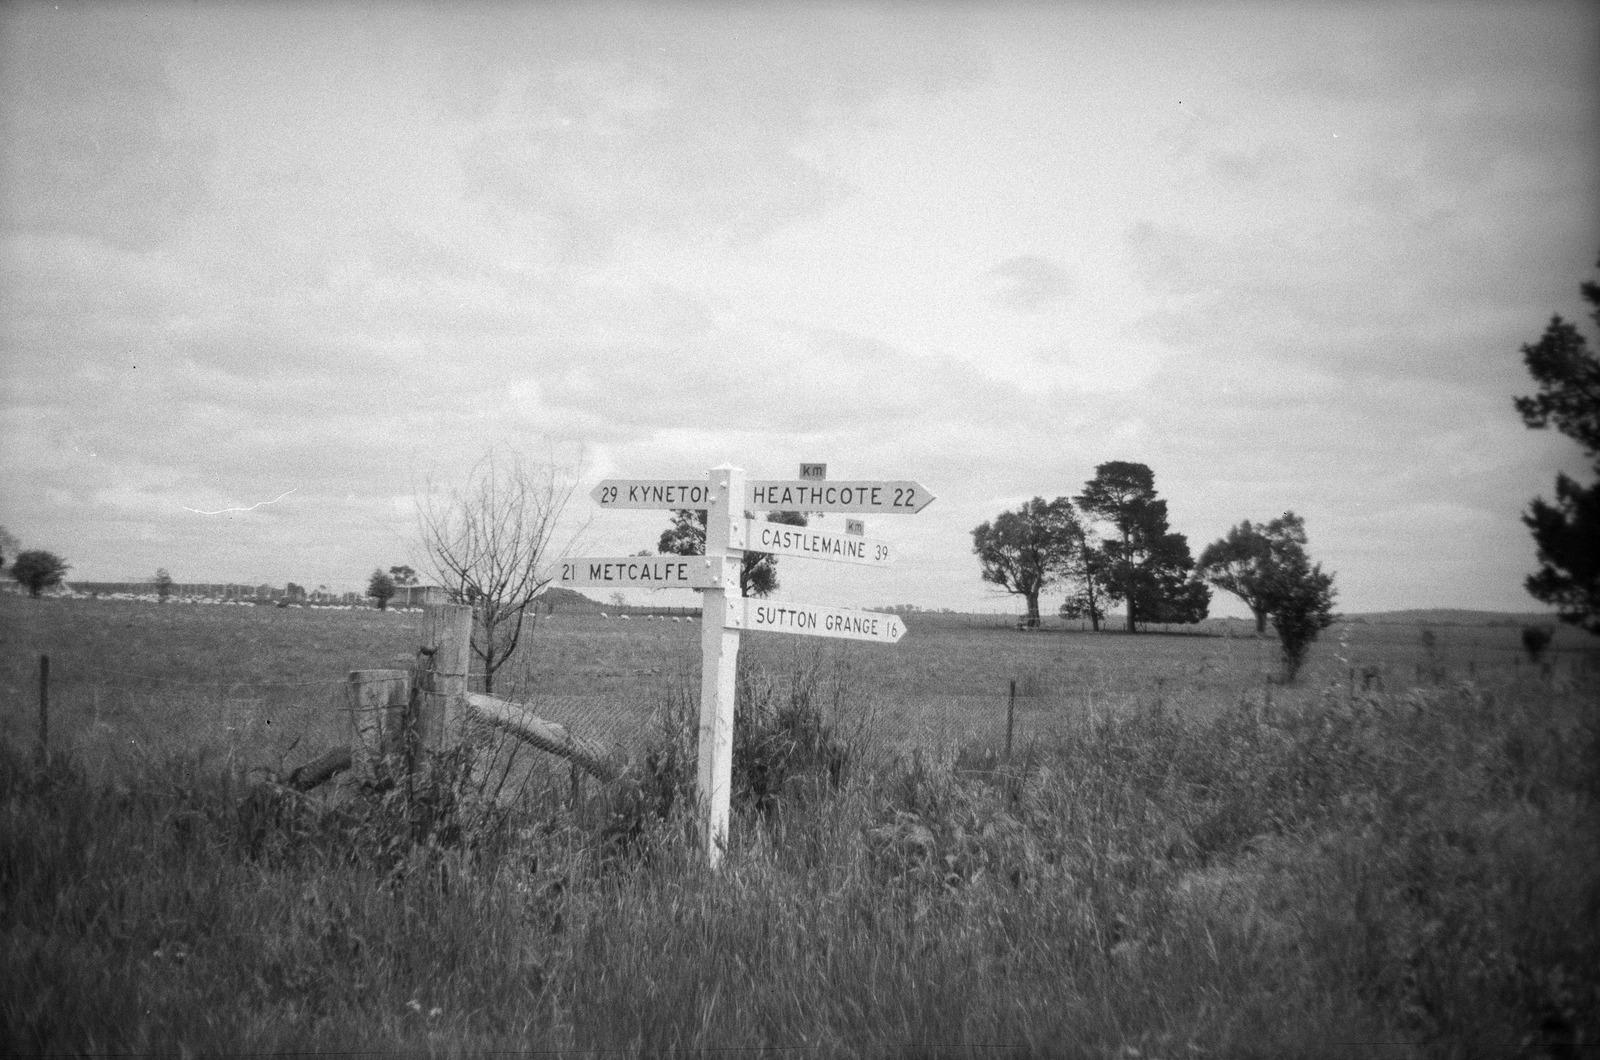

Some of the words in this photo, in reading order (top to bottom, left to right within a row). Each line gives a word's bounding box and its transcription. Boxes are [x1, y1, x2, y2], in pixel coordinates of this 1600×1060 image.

[601, 486, 618, 503] 29
[753, 486, 882, 505] HEATHCOTE
[893, 488, 915, 507] 22
[761, 528, 865, 558] CASTLEMAINE
[875, 544, 889, 561] 39
[562, 564, 575, 580] 21
[589, 563, 688, 581] METCALFE
[756, 607, 817, 629] SUTTON
[825, 615, 879, 636] GRANGE
[886, 622, 898, 638] 16
